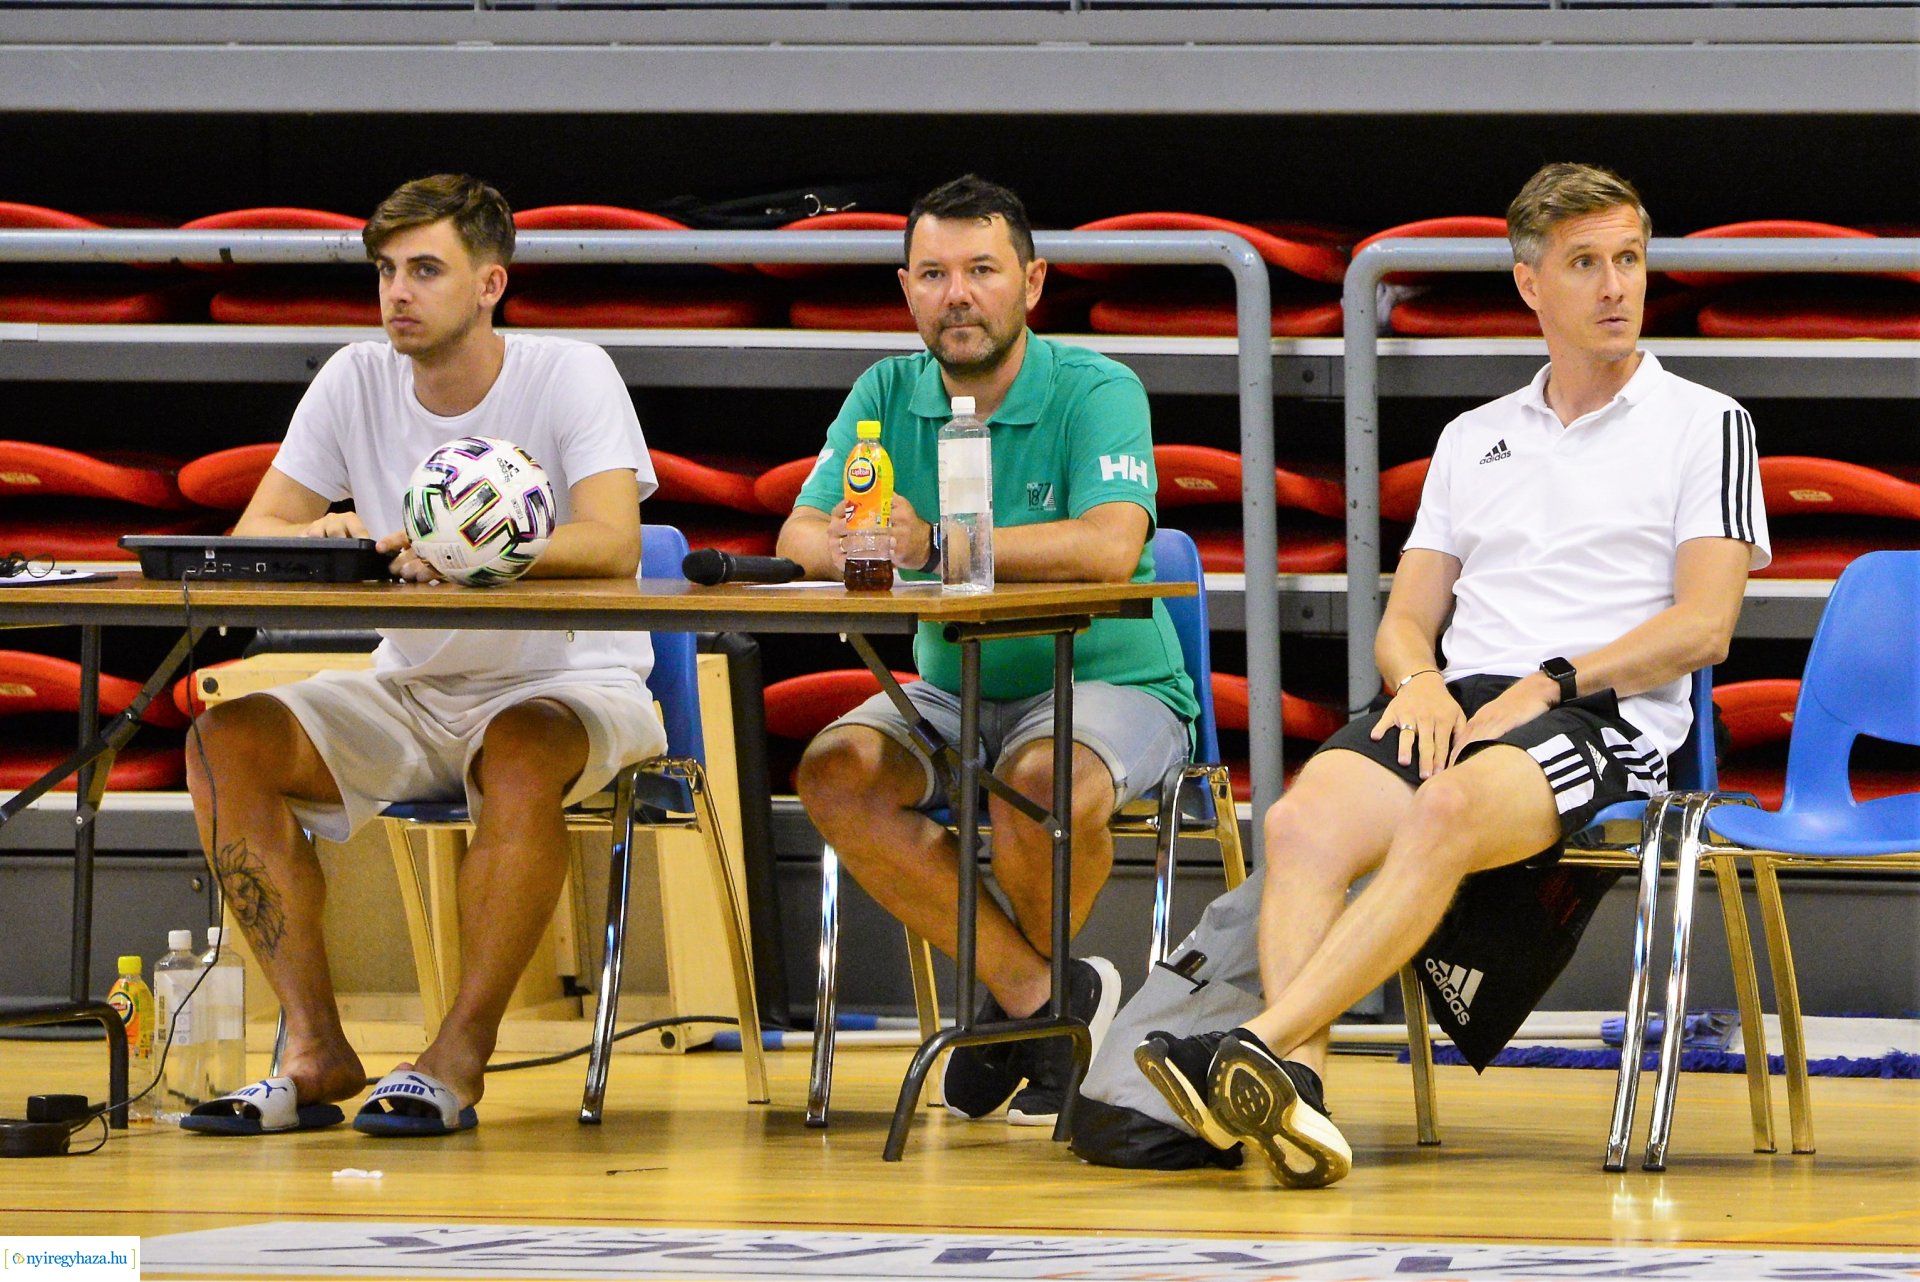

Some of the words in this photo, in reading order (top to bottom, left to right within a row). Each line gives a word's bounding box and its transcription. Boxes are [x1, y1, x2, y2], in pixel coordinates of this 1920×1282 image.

[1098, 455, 1149, 489] HH
[1479, 450, 1511, 465] adidas
[1425, 958, 1470, 1026] adidas
